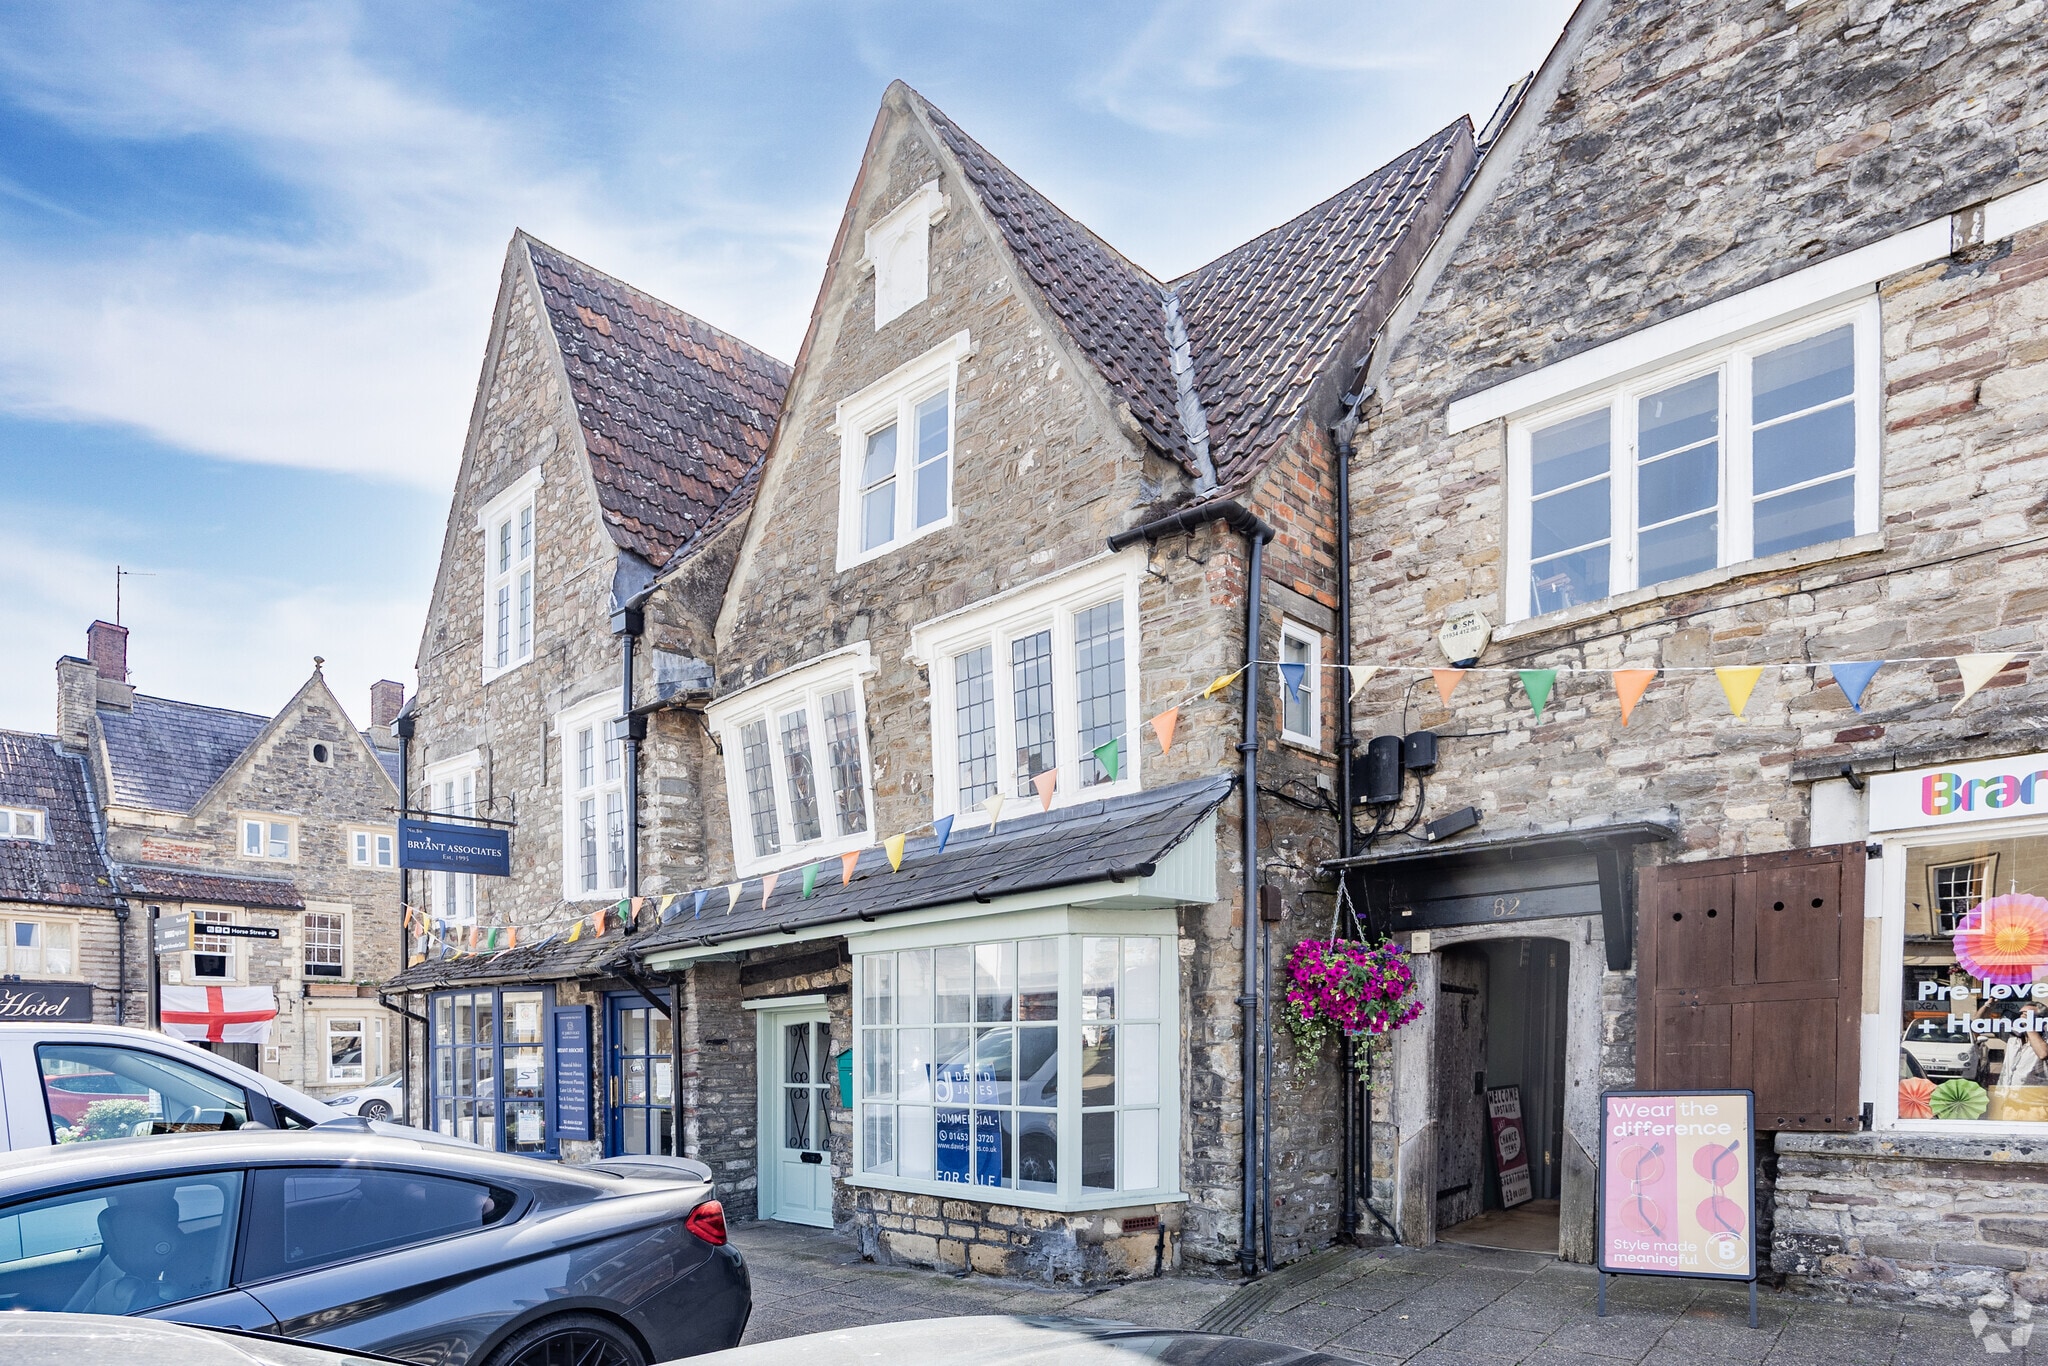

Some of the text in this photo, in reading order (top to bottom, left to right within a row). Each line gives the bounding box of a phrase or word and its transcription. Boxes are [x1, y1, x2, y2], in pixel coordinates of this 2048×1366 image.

[408, 840, 502, 857] BRYANT ASSOCIATES
[1493, 897, 1520, 917] 82
[1918, 978, 2048, 1000] Pre-love
[0, 989, 70, 1016] Hotel
[955, 1071, 990, 1082] DAID
[958, 1085, 992, 1095] JAES
[1489, 1088, 1518, 1104] WELCOME
[1613, 1101, 1718, 1118] Wear the
[937, 1113, 995, 1126] COMMECIAL
[1613, 1121, 1732, 1136] difference
[938, 1142, 997, 1152] www.david-jaes.co.uk
[964, 1173, 995, 1186] SLE
[1614, 1239, 1697, 1252] Style made
[1719, 1241, 1736, 1260] B
[1614, 1253, 1698, 1266] meaningful
